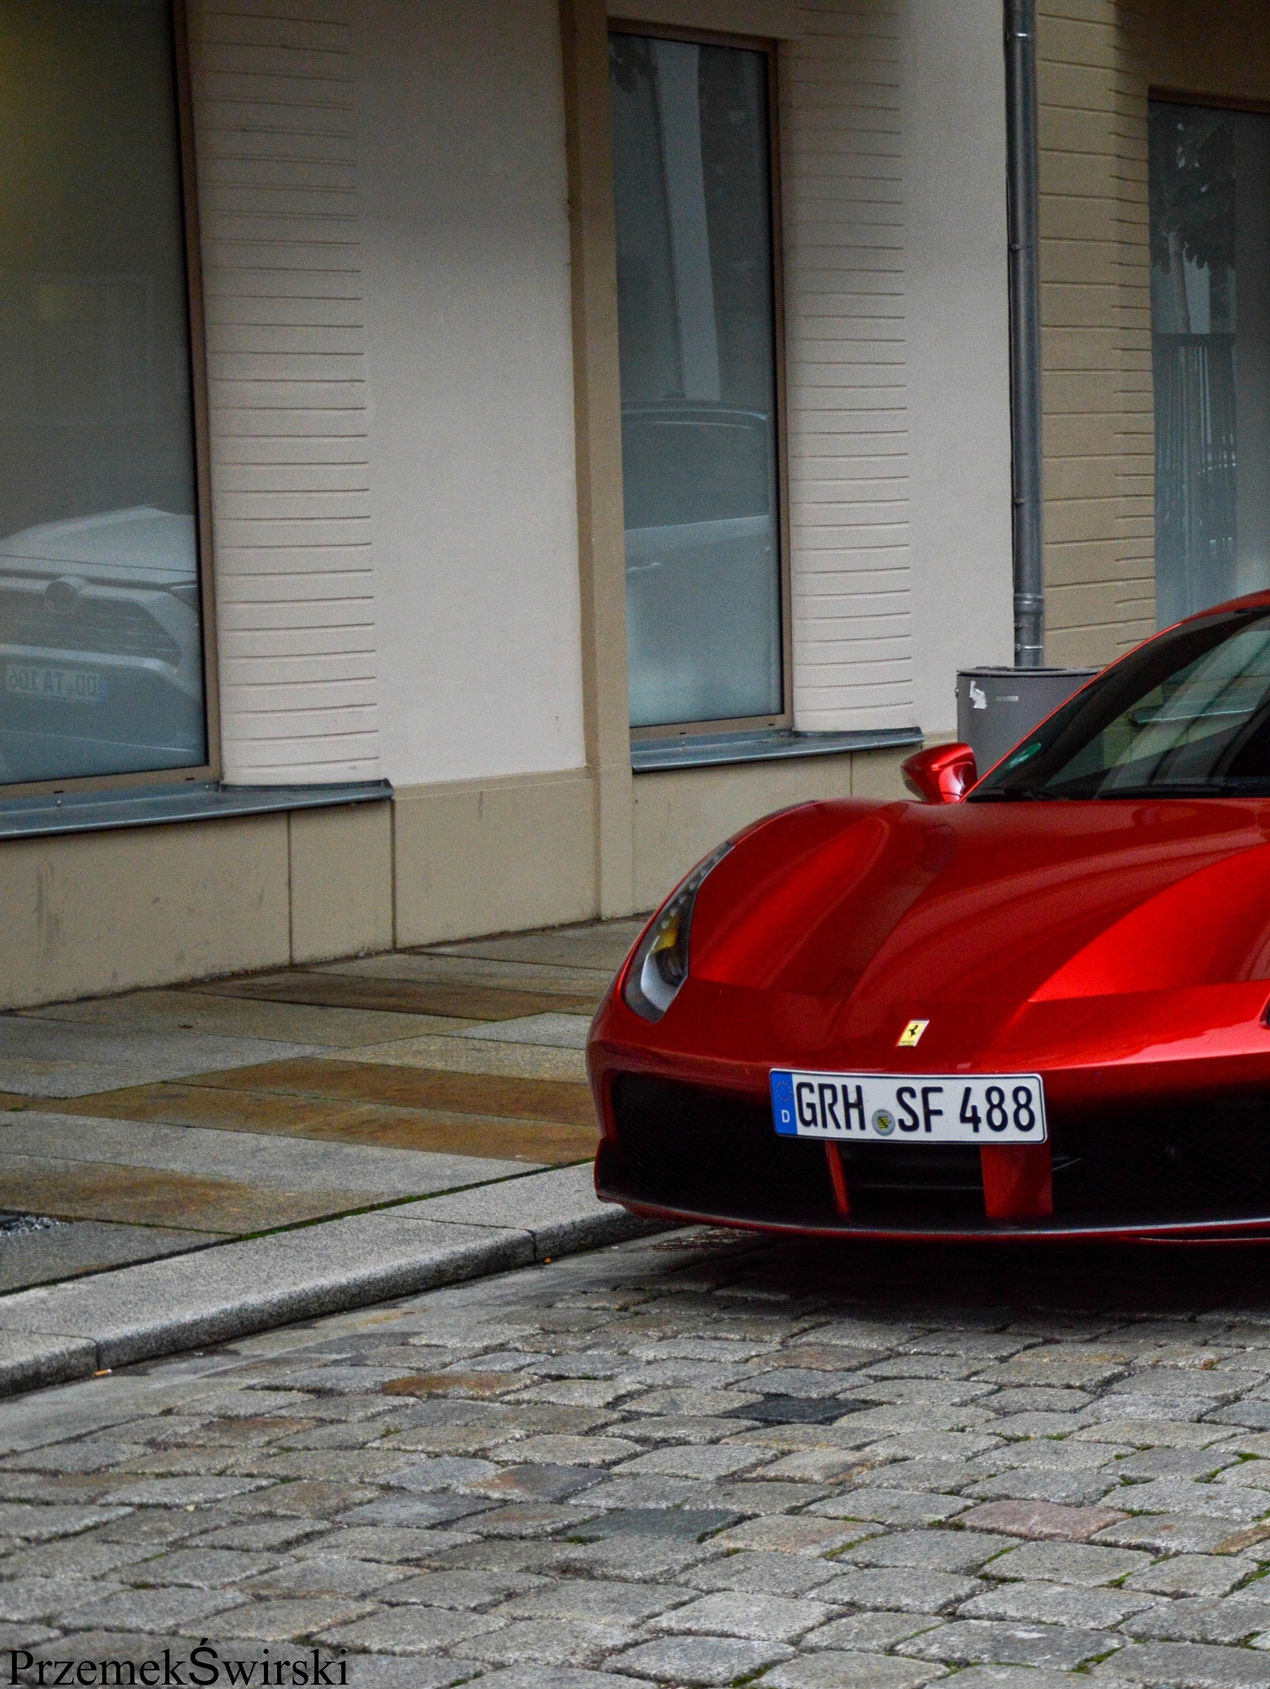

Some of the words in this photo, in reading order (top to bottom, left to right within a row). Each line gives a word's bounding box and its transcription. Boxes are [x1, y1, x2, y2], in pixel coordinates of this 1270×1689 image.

[781, 1110, 790, 1123] D
[796, 1081, 866, 1130] GRH
[896, 1086, 944, 1132] SF
[959, 1086, 1036, 1132] 488
